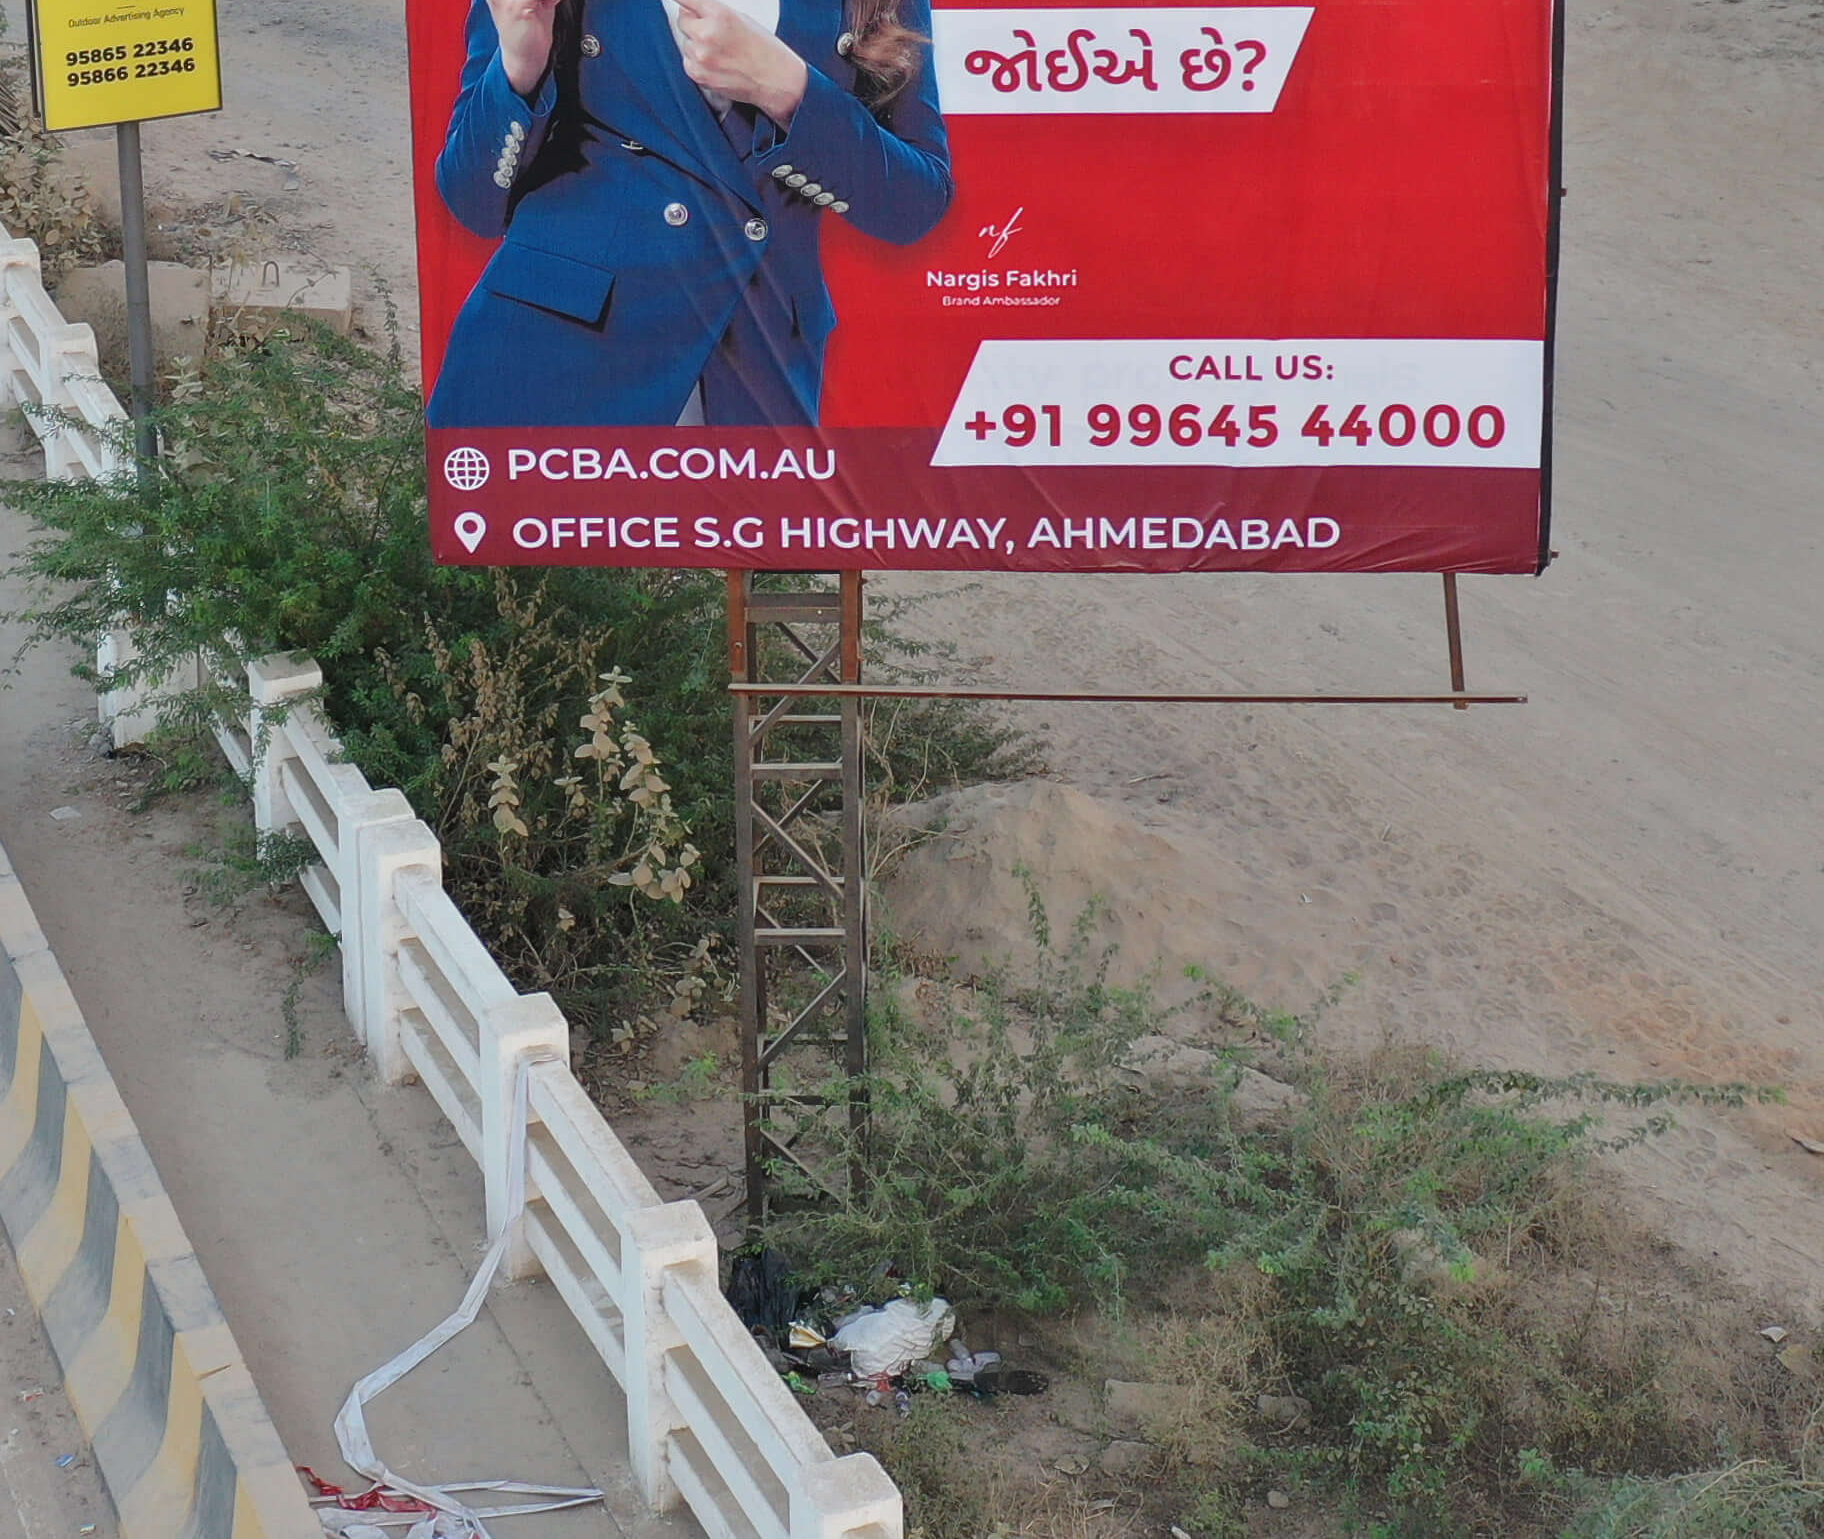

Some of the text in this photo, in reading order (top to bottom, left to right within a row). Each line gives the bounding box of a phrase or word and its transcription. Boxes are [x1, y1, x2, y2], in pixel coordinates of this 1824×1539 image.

[68, 17, 101, 29] Outdoor
[104, 10, 151, 26] Advertising
[66, 37, 194, 67] 95865 22346
[964, 27, 1268, 93] જોઈએ છે?
[67, 57, 196, 88] 95866 22346
[927, 269, 1078, 291] Nargis Fakhri
[942, 296, 1061, 307] Brand Ambassador
[1169, 353, 1335, 382] CALL US:
[964, 402, 1506, 448] +91 99645 44000
[507, 446, 837, 483] PCBA.COM.AU
[512, 516, 1342, 558] OFFICE S.G HIGHWAY, AHMEDABAD
